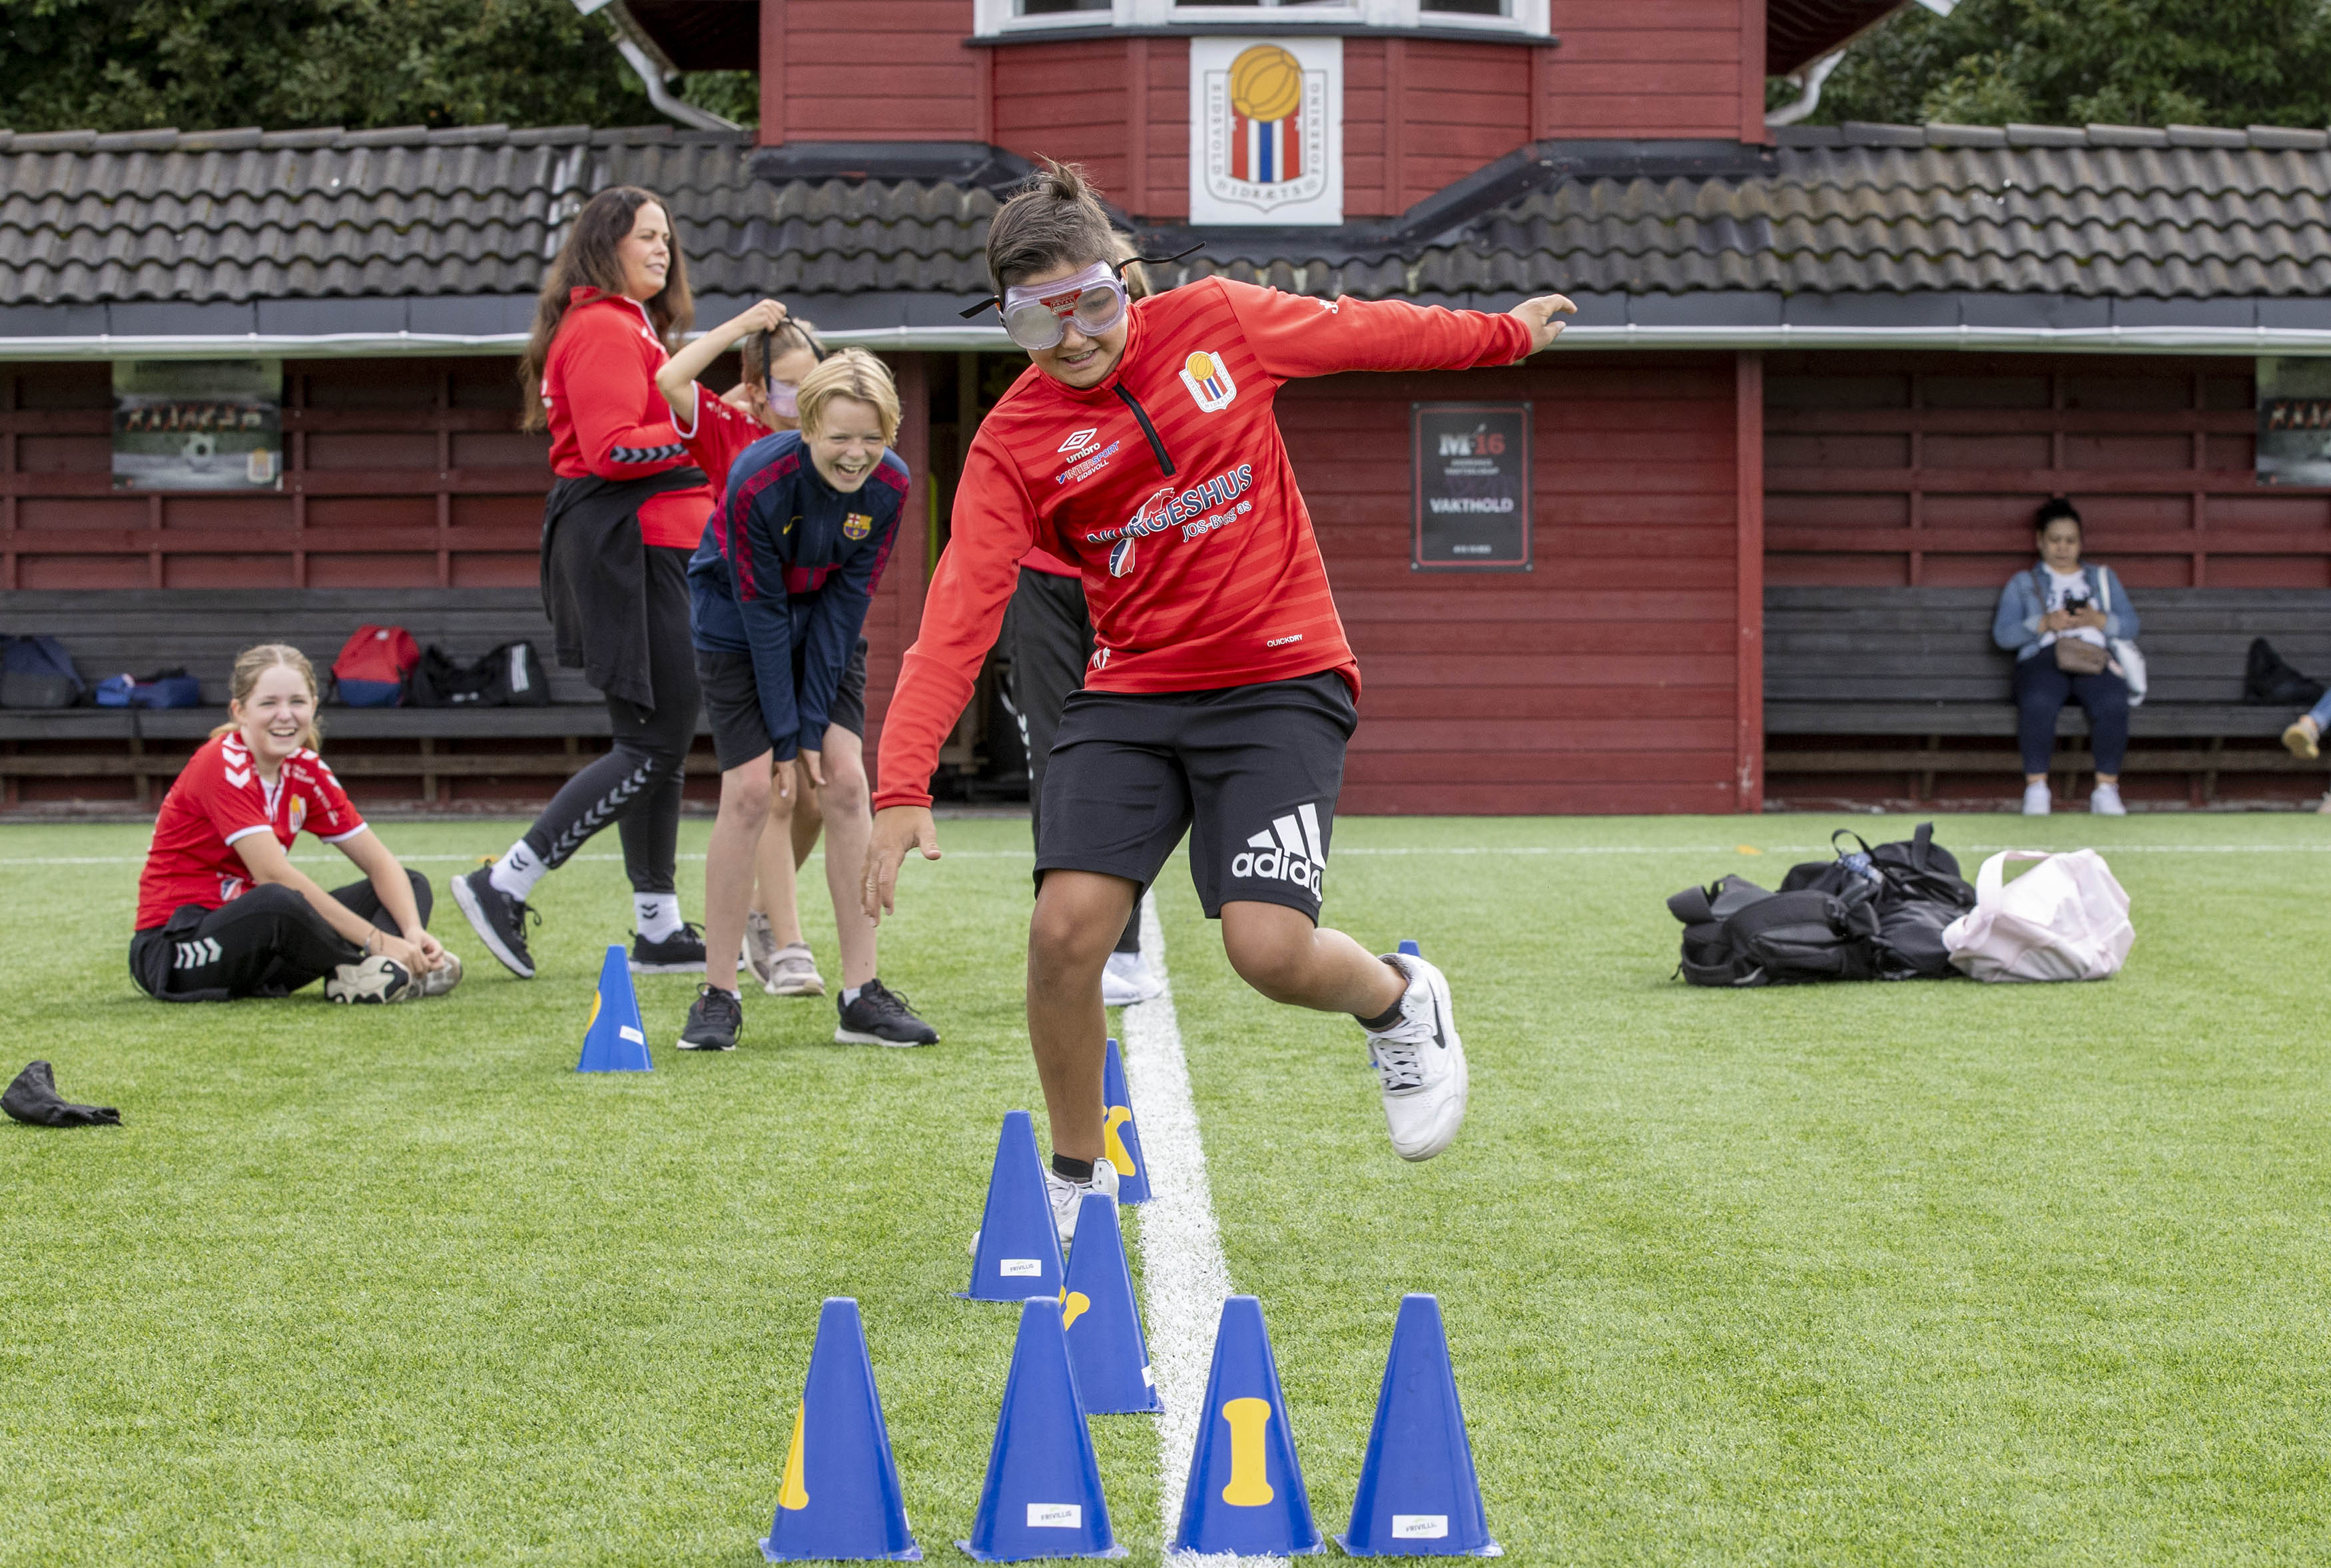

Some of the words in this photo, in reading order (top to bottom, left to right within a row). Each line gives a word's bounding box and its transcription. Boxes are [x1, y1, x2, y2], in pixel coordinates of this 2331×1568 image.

[1054, 303, 1074, 312] VISION
[1065, 440, 1120, 479] INTERSPORT
[1066, 442, 1100, 463] umbro
[1076, 459, 1110, 482] EIDSVOLL
[1237, 501, 1252, 514] as
[1267, 634, 1303, 648] QUICKDRY
[1231, 846, 1323, 902] adida
